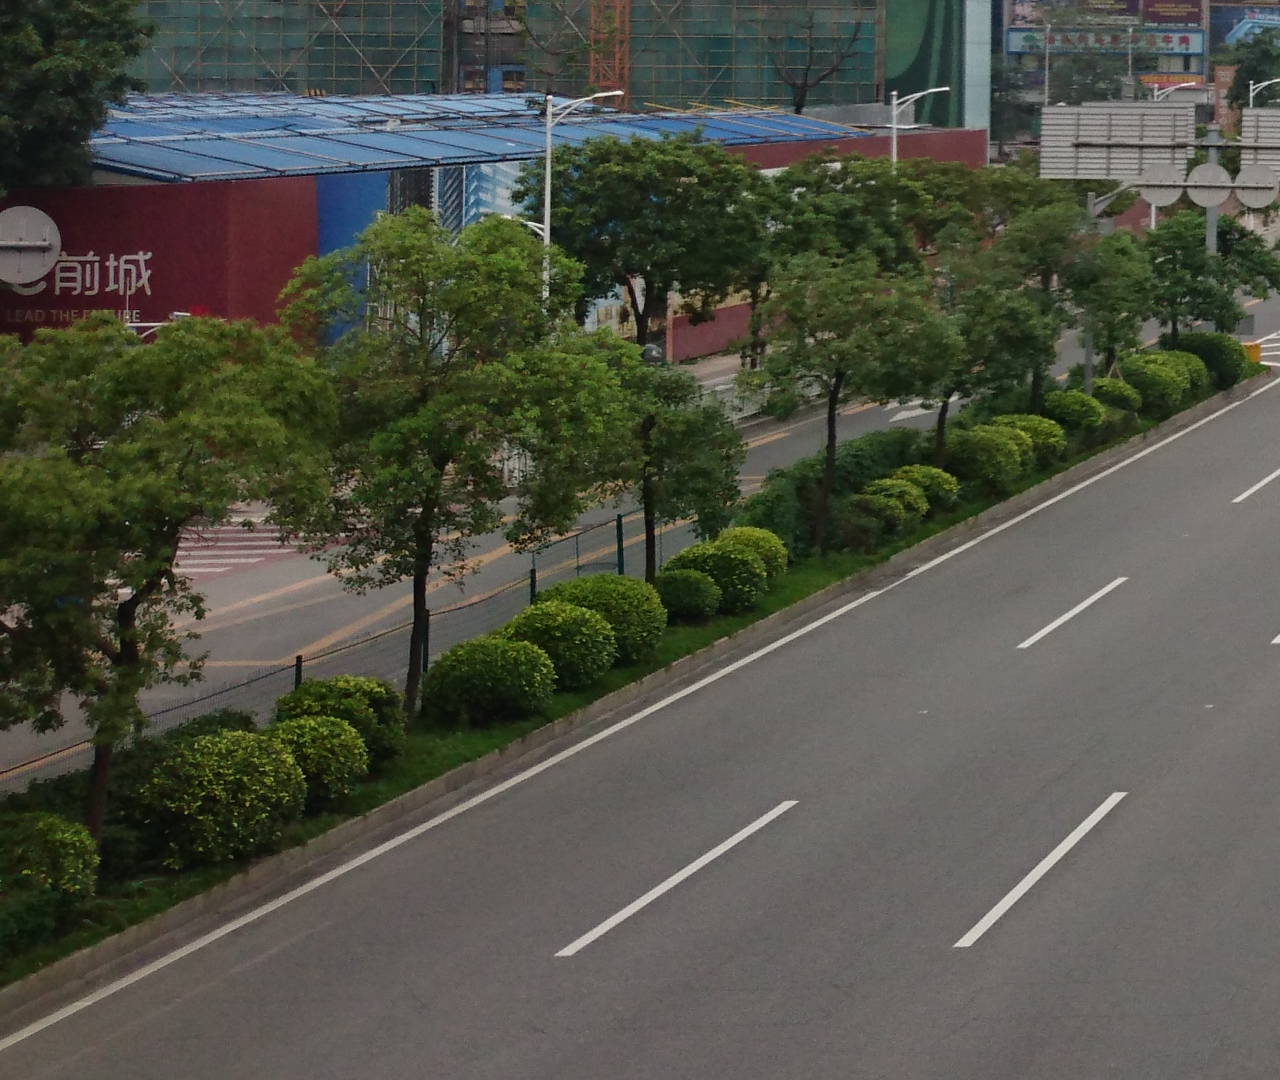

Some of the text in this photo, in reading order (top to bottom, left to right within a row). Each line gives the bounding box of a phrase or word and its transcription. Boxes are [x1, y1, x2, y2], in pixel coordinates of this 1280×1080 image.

[13, 251, 152, 296] 前城
[7, 310, 45, 322] LEAD
[50, 310, 79, 322] THE
